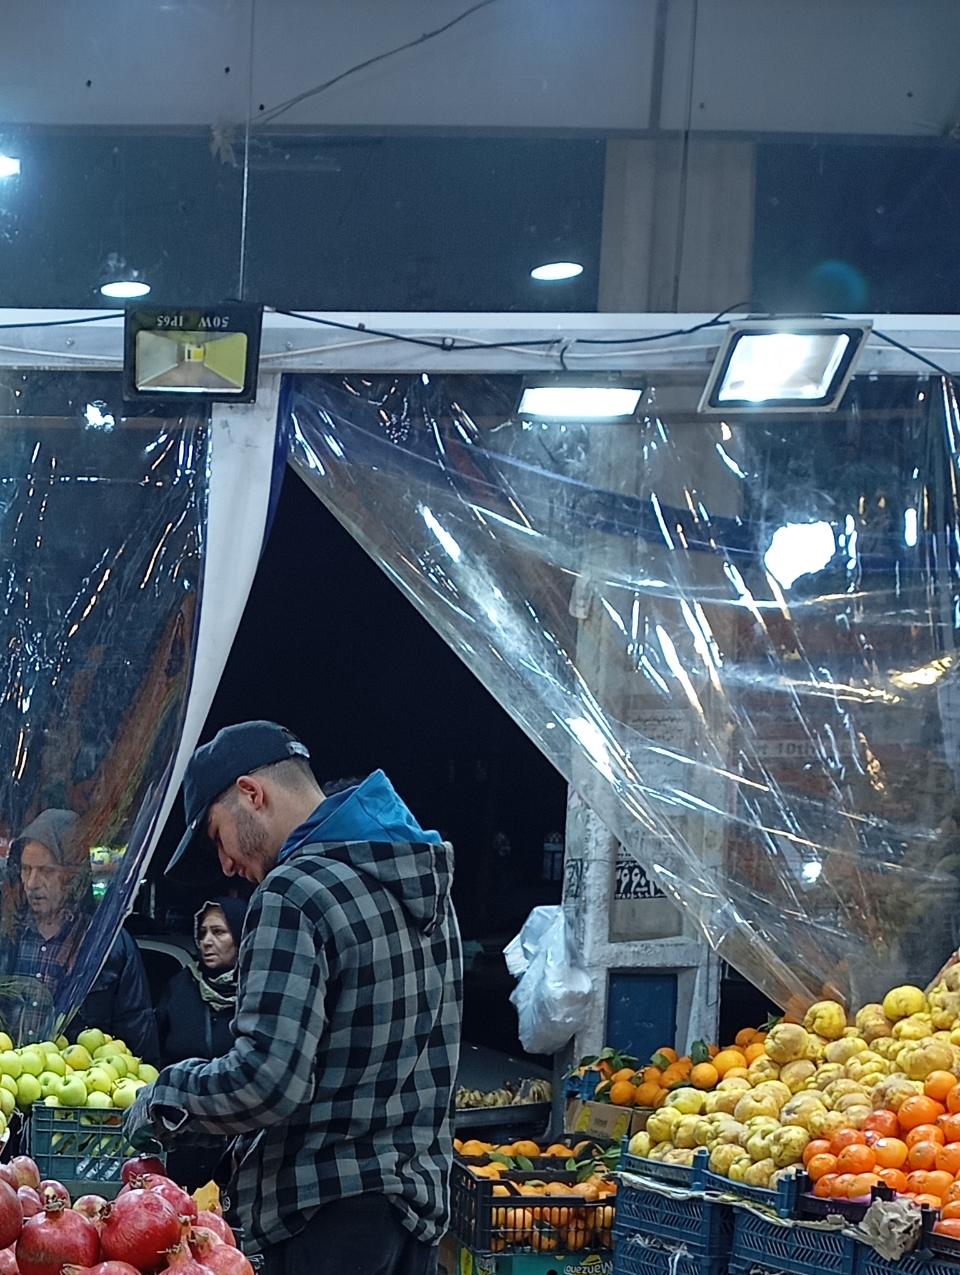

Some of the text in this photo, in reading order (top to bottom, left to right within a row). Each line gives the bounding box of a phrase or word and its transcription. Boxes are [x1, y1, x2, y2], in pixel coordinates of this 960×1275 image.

[156, 315, 230, 328] 50W IP65
[564, 1260, 614, 1275] Manzano
